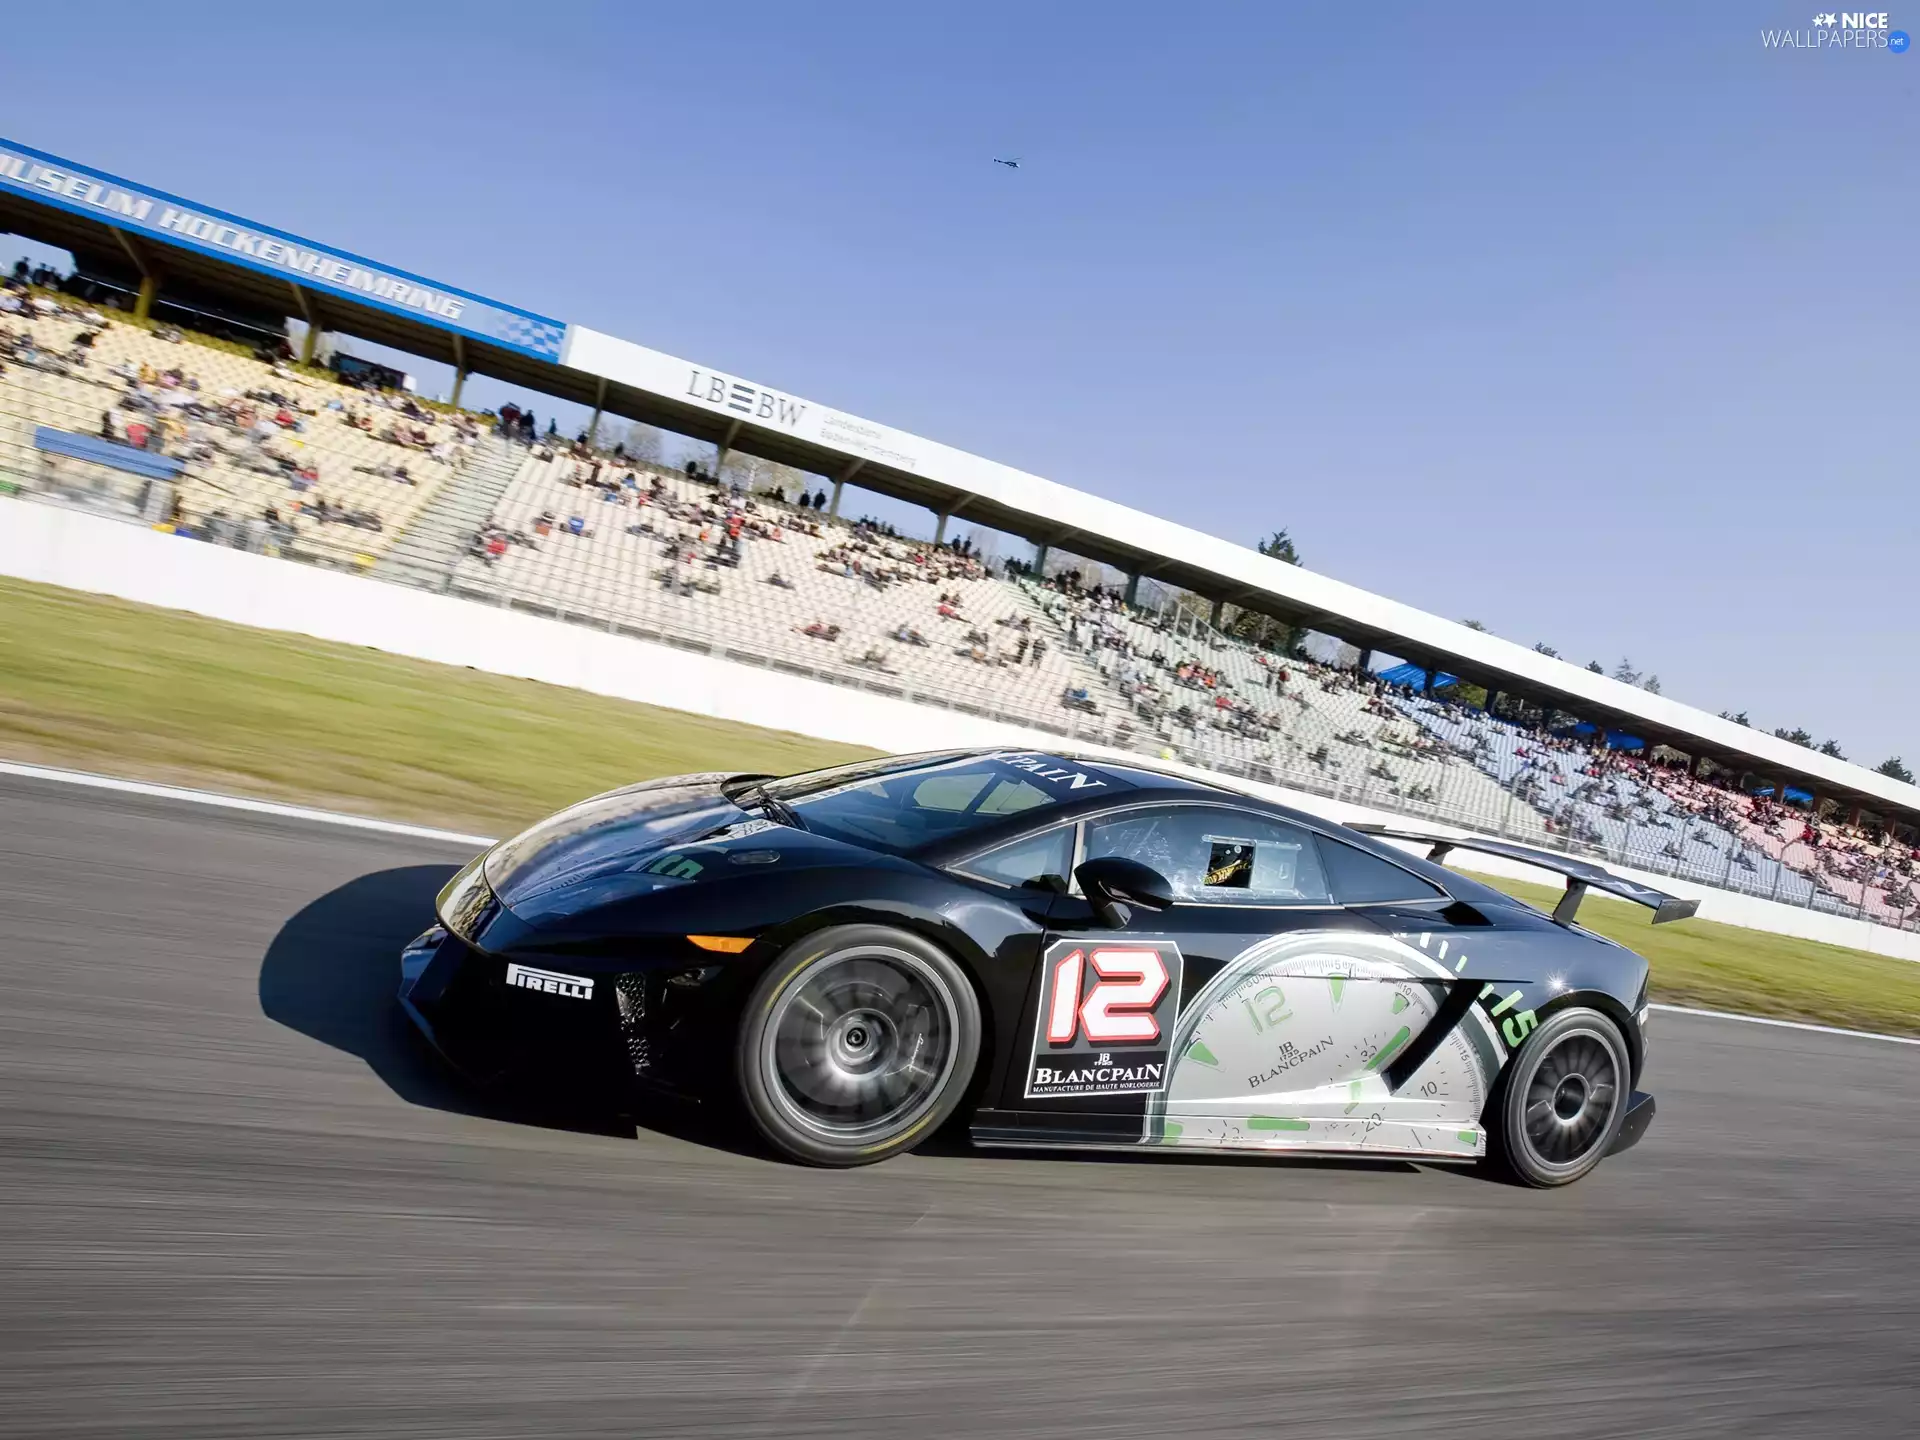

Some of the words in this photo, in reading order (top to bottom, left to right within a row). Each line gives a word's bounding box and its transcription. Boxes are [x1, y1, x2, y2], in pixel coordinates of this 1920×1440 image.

[158, 208, 466, 320] HOCKENHEIMRING
[1002, 755, 1108, 790] PAIN
[506, 962, 594, 1000] PIRELLI
[1047, 948, 1169, 1042] 12
[1241, 985, 1294, 1036] 12
[1034, 1063, 1164, 1084] BLANCPAIN
[1248, 1035, 1334, 1089] BLANCPAIN
[1033, 1084, 1084, 1092] MANUFACTURE
[1119, 1081, 1160, 1089] HORLOGERIE
[1420, 1081, 1438, 1098] 10
